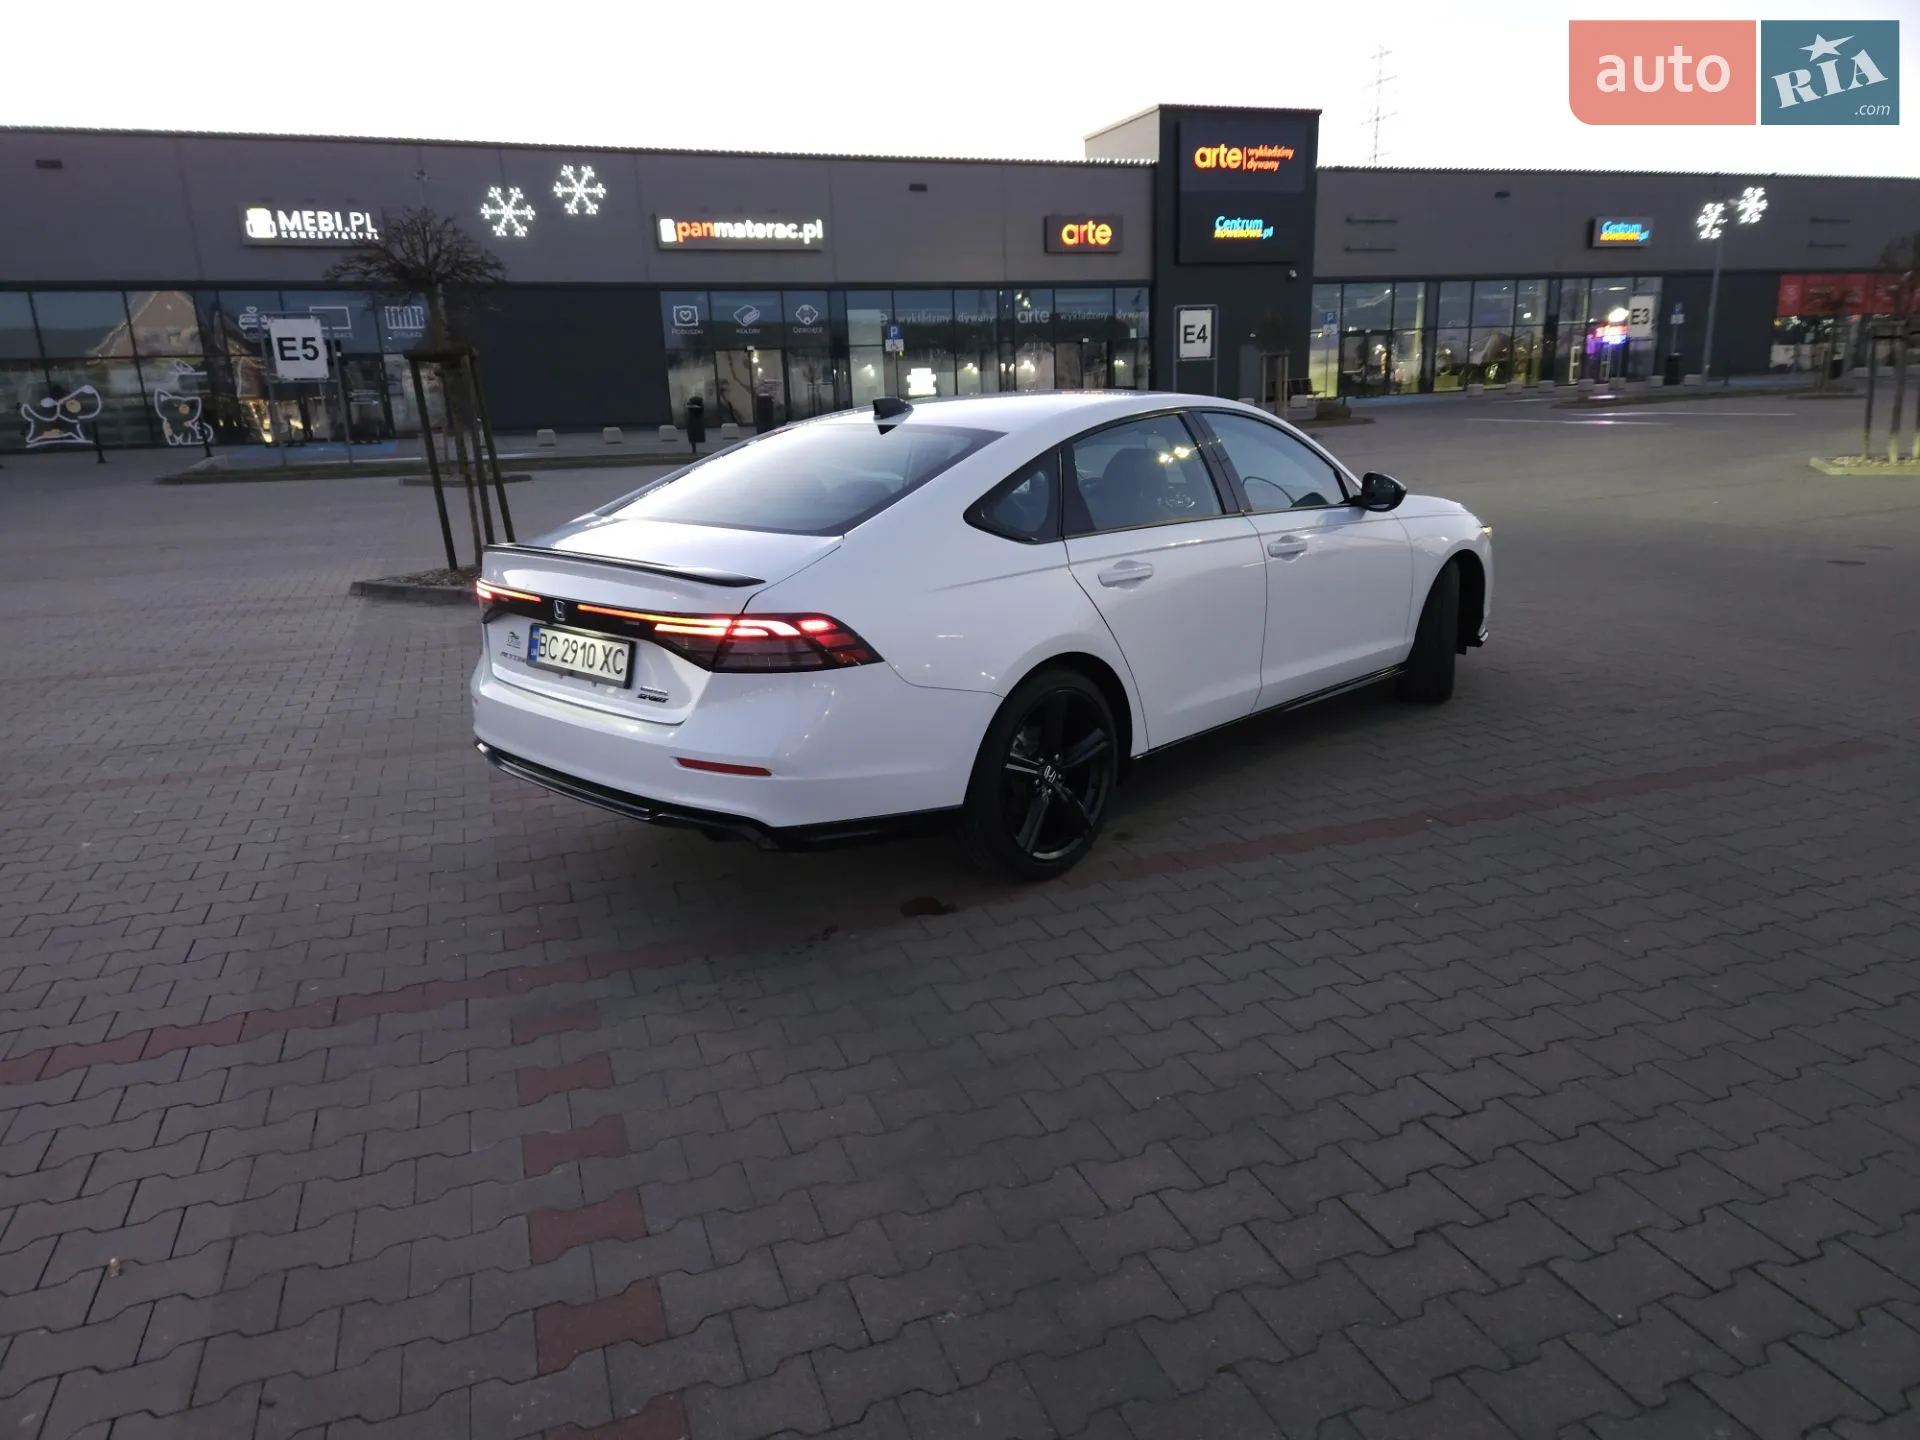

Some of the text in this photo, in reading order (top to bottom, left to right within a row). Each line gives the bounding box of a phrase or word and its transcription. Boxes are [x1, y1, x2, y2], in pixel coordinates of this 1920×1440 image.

[1194, 143, 1243, 169] arte
[277, 210, 378, 233] MEBI.PL
[676, 219, 824, 245] panmaterac.pl
[1061, 219, 1113, 246] arte
[1215, 216, 1264, 231] Centrum
[1016, 308, 1051, 324] arte
[1630, 307, 1650, 325] E3
[1183, 324, 1209, 344] E4
[276, 336, 320, 362] E5
[538, 633, 625, 675] BC 2910 XC
